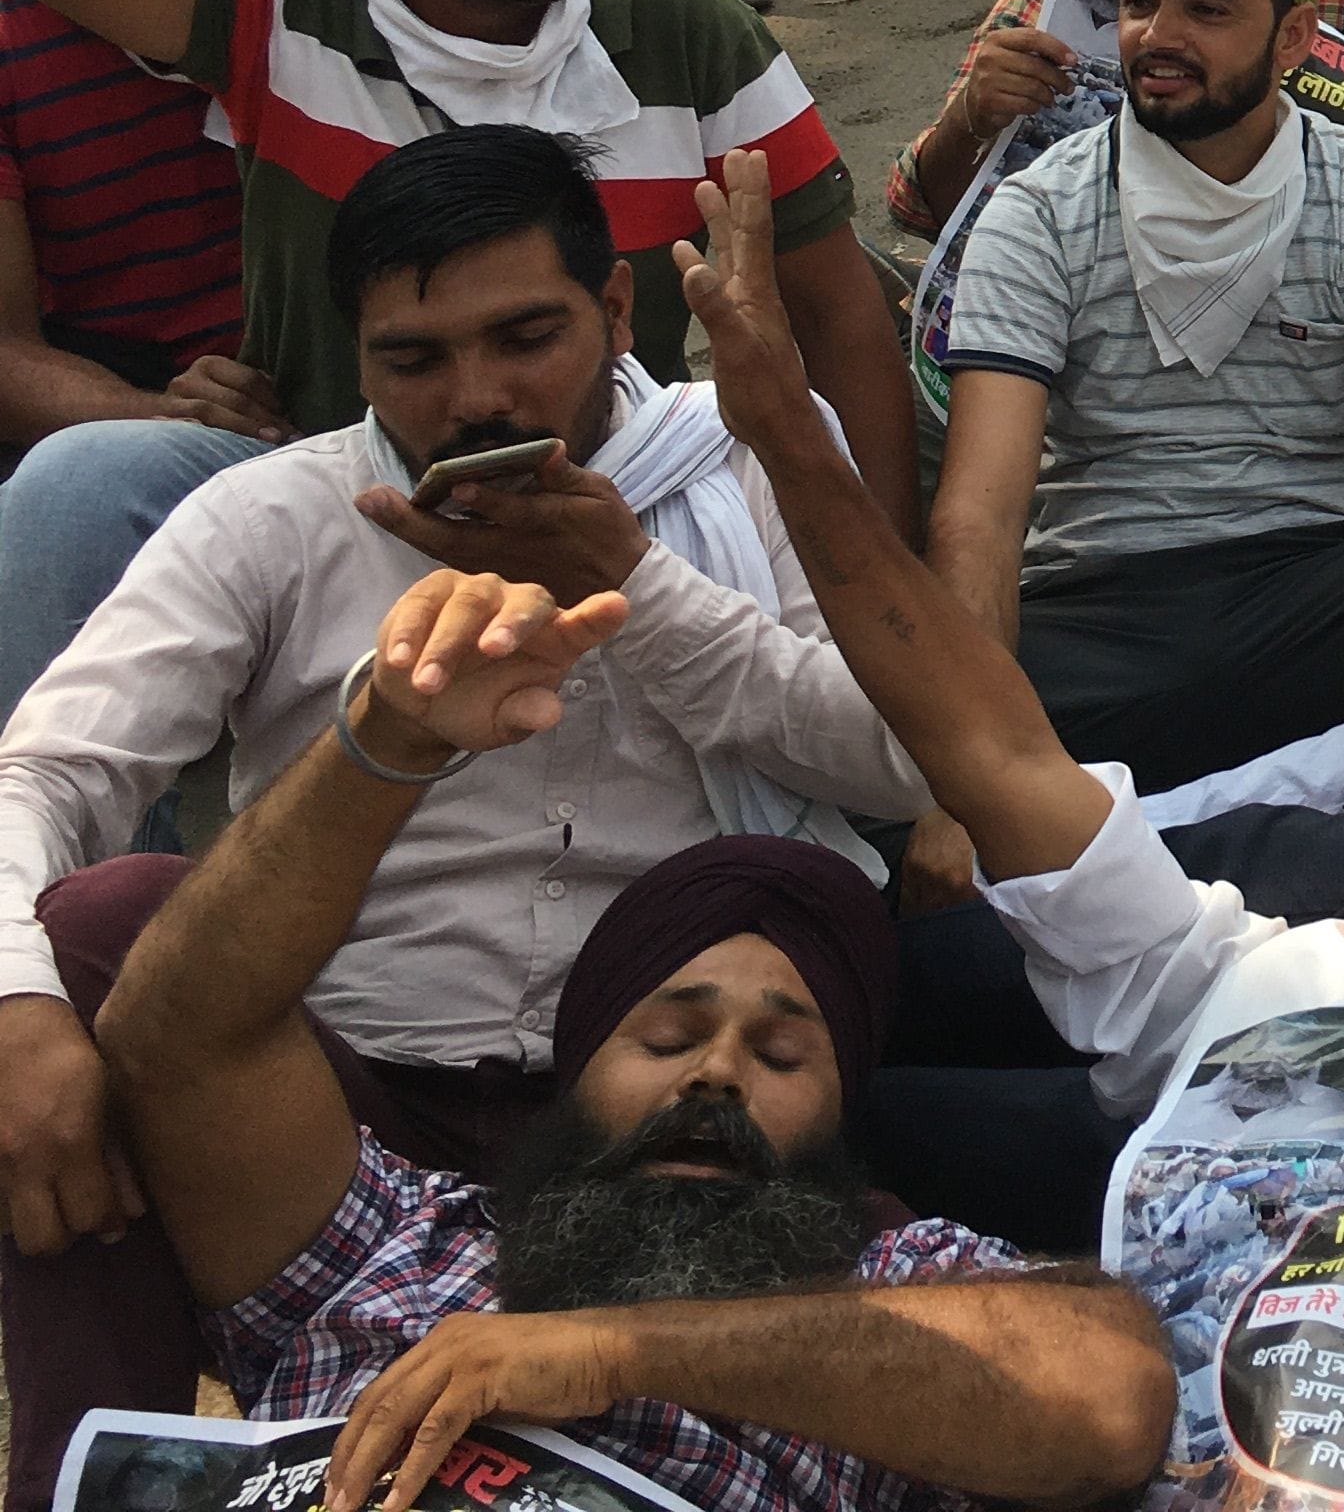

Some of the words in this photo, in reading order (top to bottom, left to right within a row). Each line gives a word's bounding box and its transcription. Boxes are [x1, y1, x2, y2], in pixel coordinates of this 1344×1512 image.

[1280, 1262, 1315, 1282] हर
[1255, 1293, 1300, 1319] विज
[1304, 1287, 1341, 1315] तेरे
[1251, 1339, 1312, 1367] धरती
[226, 1460, 277, 1508] जो
